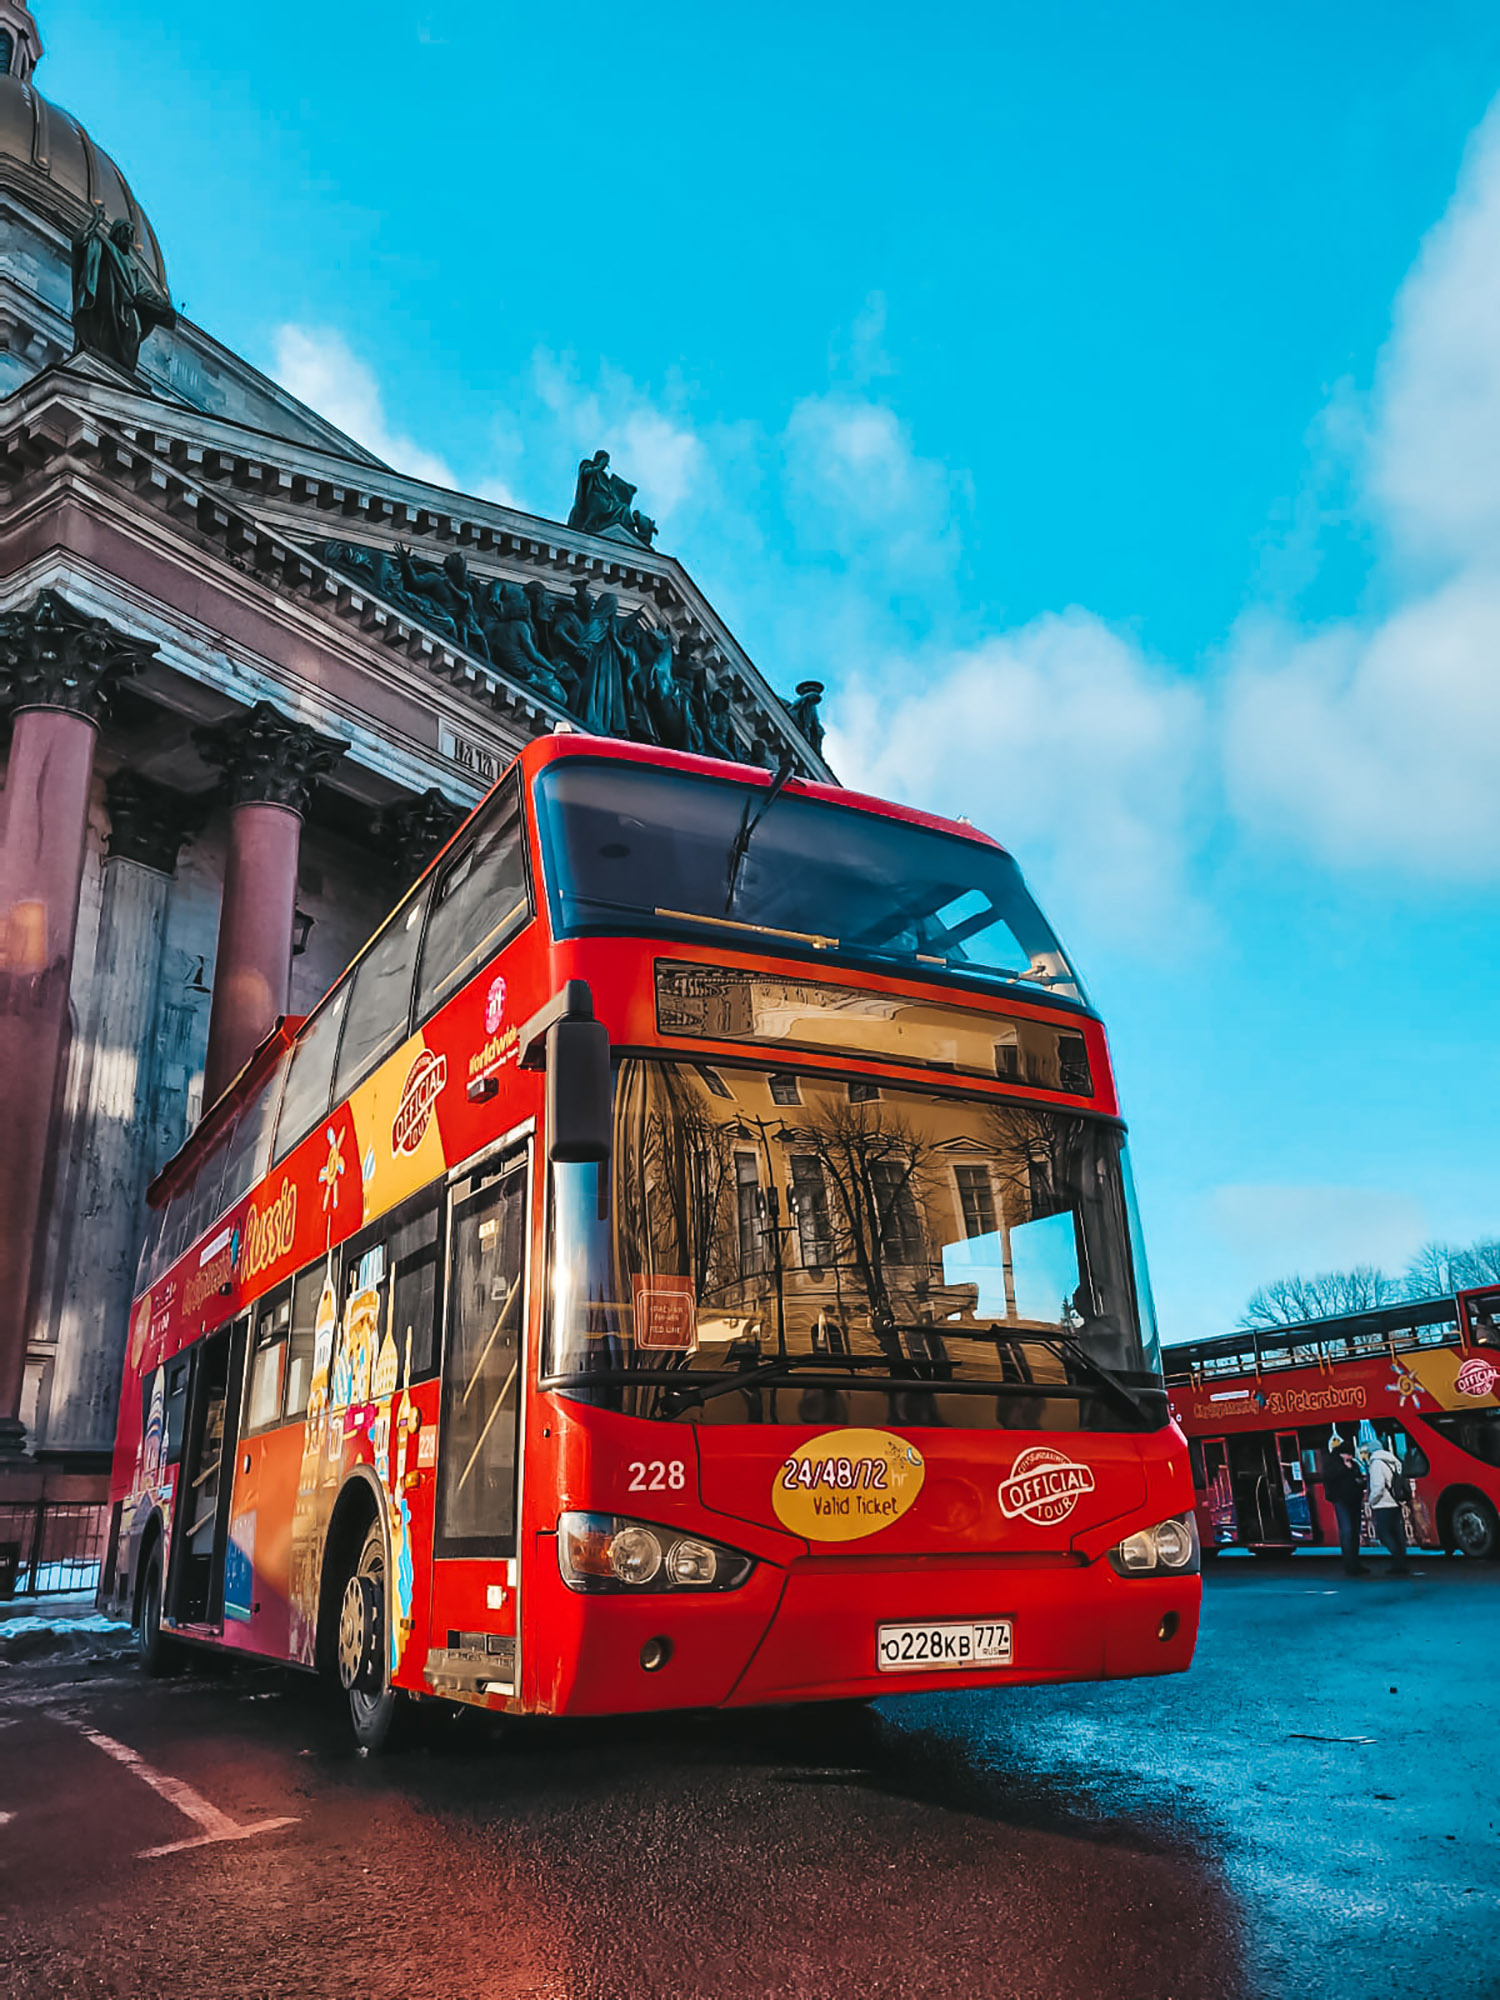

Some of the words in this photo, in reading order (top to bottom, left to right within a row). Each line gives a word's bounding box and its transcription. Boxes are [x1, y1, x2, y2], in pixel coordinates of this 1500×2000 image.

[396, 1063, 444, 1142] OFFICIAL
[240, 1177, 298, 1284] Russia
[1457, 1368, 1498, 1391] OFFICIAL
[1286, 1384, 1367, 1413] Petersburg
[628, 1460, 686, 1492] 228
[782, 1457, 888, 1490] 24/48/72
[1009, 1469, 1090, 1507] OFFICIAL
[813, 1496, 850, 1515] Valid
[856, 1495, 899, 1515] Ticket
[1037, 1496, 1073, 1519] TOUR
[974, 1626, 1005, 1648] 777
